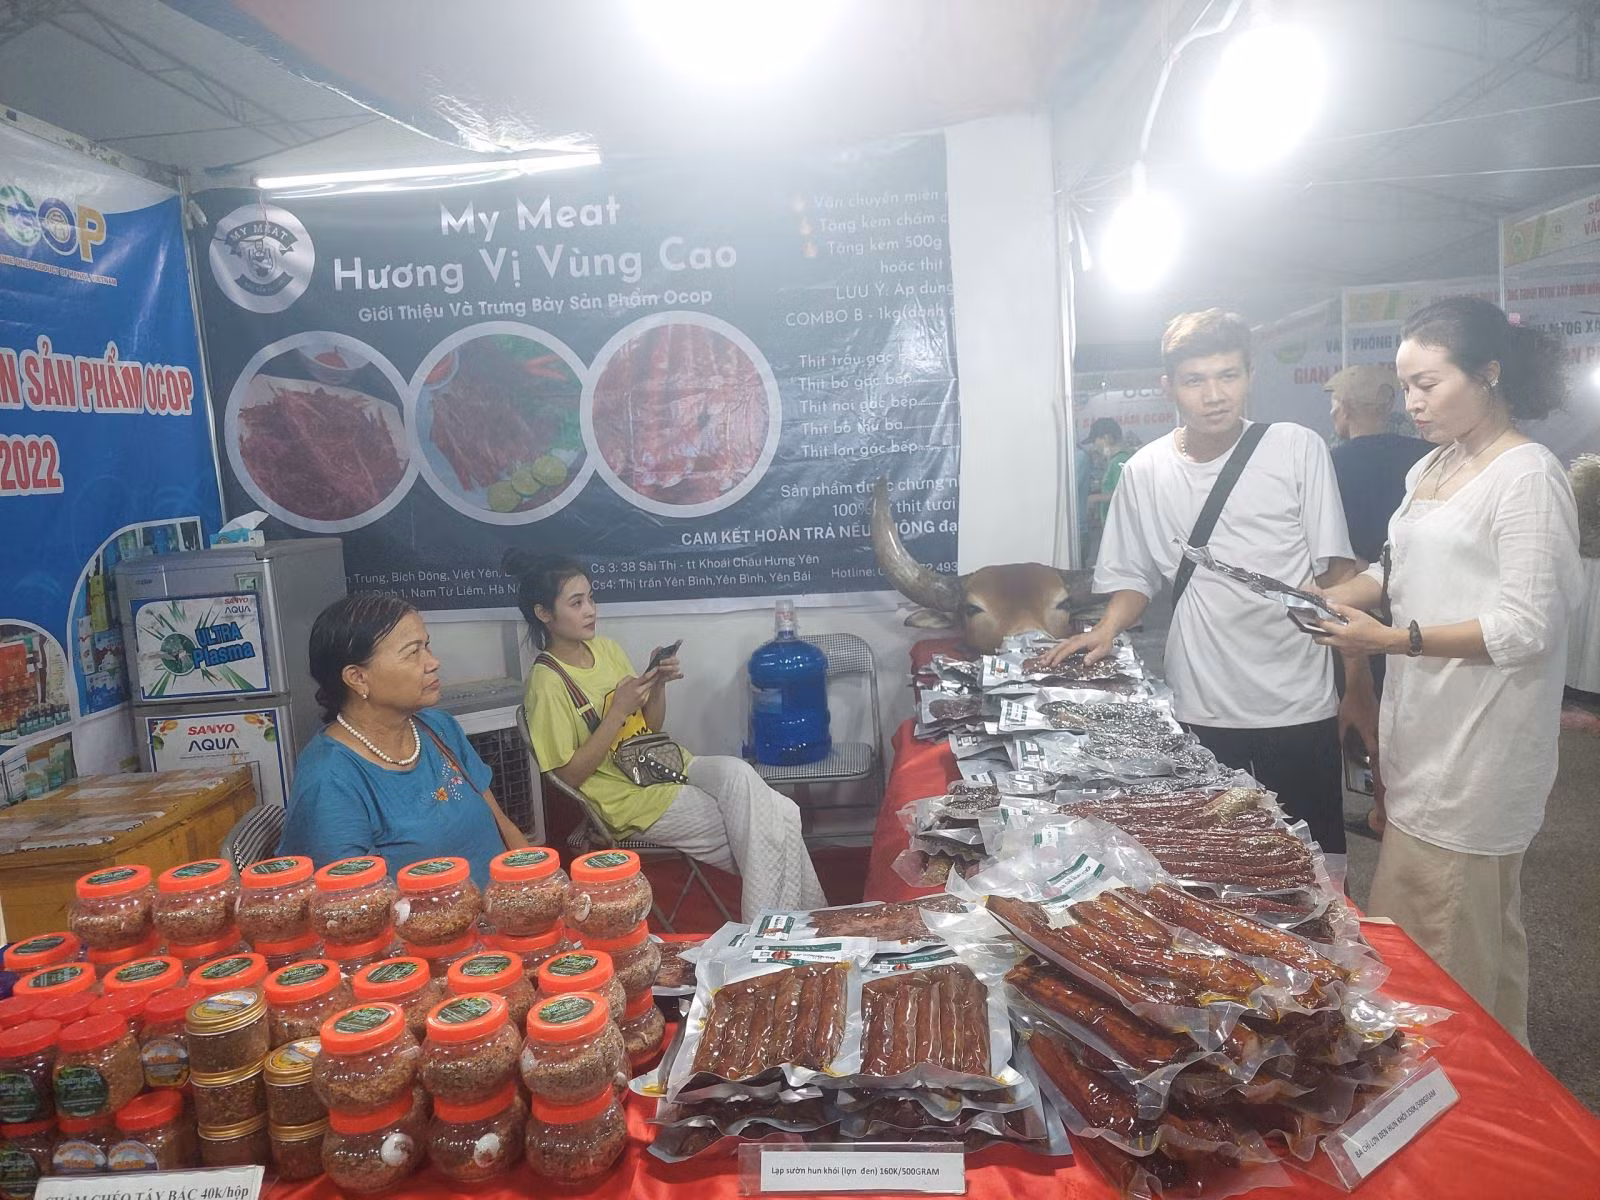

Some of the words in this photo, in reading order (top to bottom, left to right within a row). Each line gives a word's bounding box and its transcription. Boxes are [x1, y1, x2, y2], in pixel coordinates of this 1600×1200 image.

[440, 200, 499, 242] My
[516, 195, 620, 231] Meat
[230, 227, 248, 241] MY
[253, 224, 288, 240] MEAT
[905, 235, 943, 250] 500g
[333, 258, 464, 294] Hương
[479, 247, 521, 288] Vị
[535, 244, 643, 283] Vùng
[658, 236, 737, 272] Cao
[920, 257, 943, 272] thịt
[358, 305, 393, 322] Giới
[398, 303, 443, 323] Thiệu
[449, 301, 474, 317] Và
[478, 300, 526, 318] Trưng
[532, 296, 564, 314] Bày
[569, 292, 602, 310] Sản
[607, 288, 658, 308] Phẩm
[663, 290, 712, 305] Ocop
[785, 309, 848, 327] COMBO
[854, 308, 864, 321] B
[23, 339, 77, 408] SẢN
[78, 345, 143, 410] PHẨM
[145, 367, 193, 412] OCOP
[0, 439, 62, 490] 2022
[781, 482, 808, 498] Sản
[812, 479, 852, 499] phẩm
[856, 479, 893, 494] đưc
[896, 500, 921, 515] thịt
[926, 497, 956, 512] tươi
[681, 531, 717, 546] CAM
[721, 526, 751, 543] KẾT
[755, 526, 800, 542] HOÀN
[804, 522, 836, 540] TRẢ
[839, 519, 871, 538] NẾU
[591, 563, 605, 573] Cs
[608, 562, 618, 573] 3:
[621, 561, 636, 573] 38
[639, 560, 656, 571] Sài
[659, 559, 676, 572] Thị
[687, 560, 696, 569] tt
[699, 557, 730, 569] Khoái
[732, 556, 762, 567] Châu
[764, 555, 796, 567] Hưng
[798, 553, 820, 565] Yên
[936, 562, 958, 573] 493
[354, 574, 389, 585] Trung,
[391, 571, 414, 582] Bích
[452, 568, 475, 580] Việt
[477, 568, 501, 578] Yên,
[591, 579, 616, 590] Cs4:
[619, 579, 636, 591] Thị
[639, 576, 662, 588] trấn
[664, 577, 685, 587] Yên
[739, 573, 767, 584] Bình,
[769, 572, 791, 582] Yên
[793, 570, 811, 582] Bái
[831, 568, 875, 579] Hotline:
[411, 587, 436, 598] Nam
[456, 586, 486, 596] Liêm,
[489, 584, 504, 595] Hà
[224, 597, 249, 605] SANYO
[224, 605, 251, 614] AQUA
[195, 621, 244, 647] ULTRA
[192, 641, 256, 669] Plasma
[187, 723, 235, 736] SANYO
[188, 737, 239, 752] AQUA
[1354, 1148, 1363, 1158] BA
[1386, 1119, 1399, 1132] HUN
[771, 1167, 784, 1176] Lạp
[786, 1166, 806, 1175] sườn
[807, 1166, 822, 1175] hun
[823, 1165, 840, 1175] khói
[841, 1166, 857, 1176] (lợn
[860, 1166, 878, 1176] đen)
[879, 1166, 940, 1176] 160K/500GRAM
[200, 1184, 250, 1200] 40k/hộp
